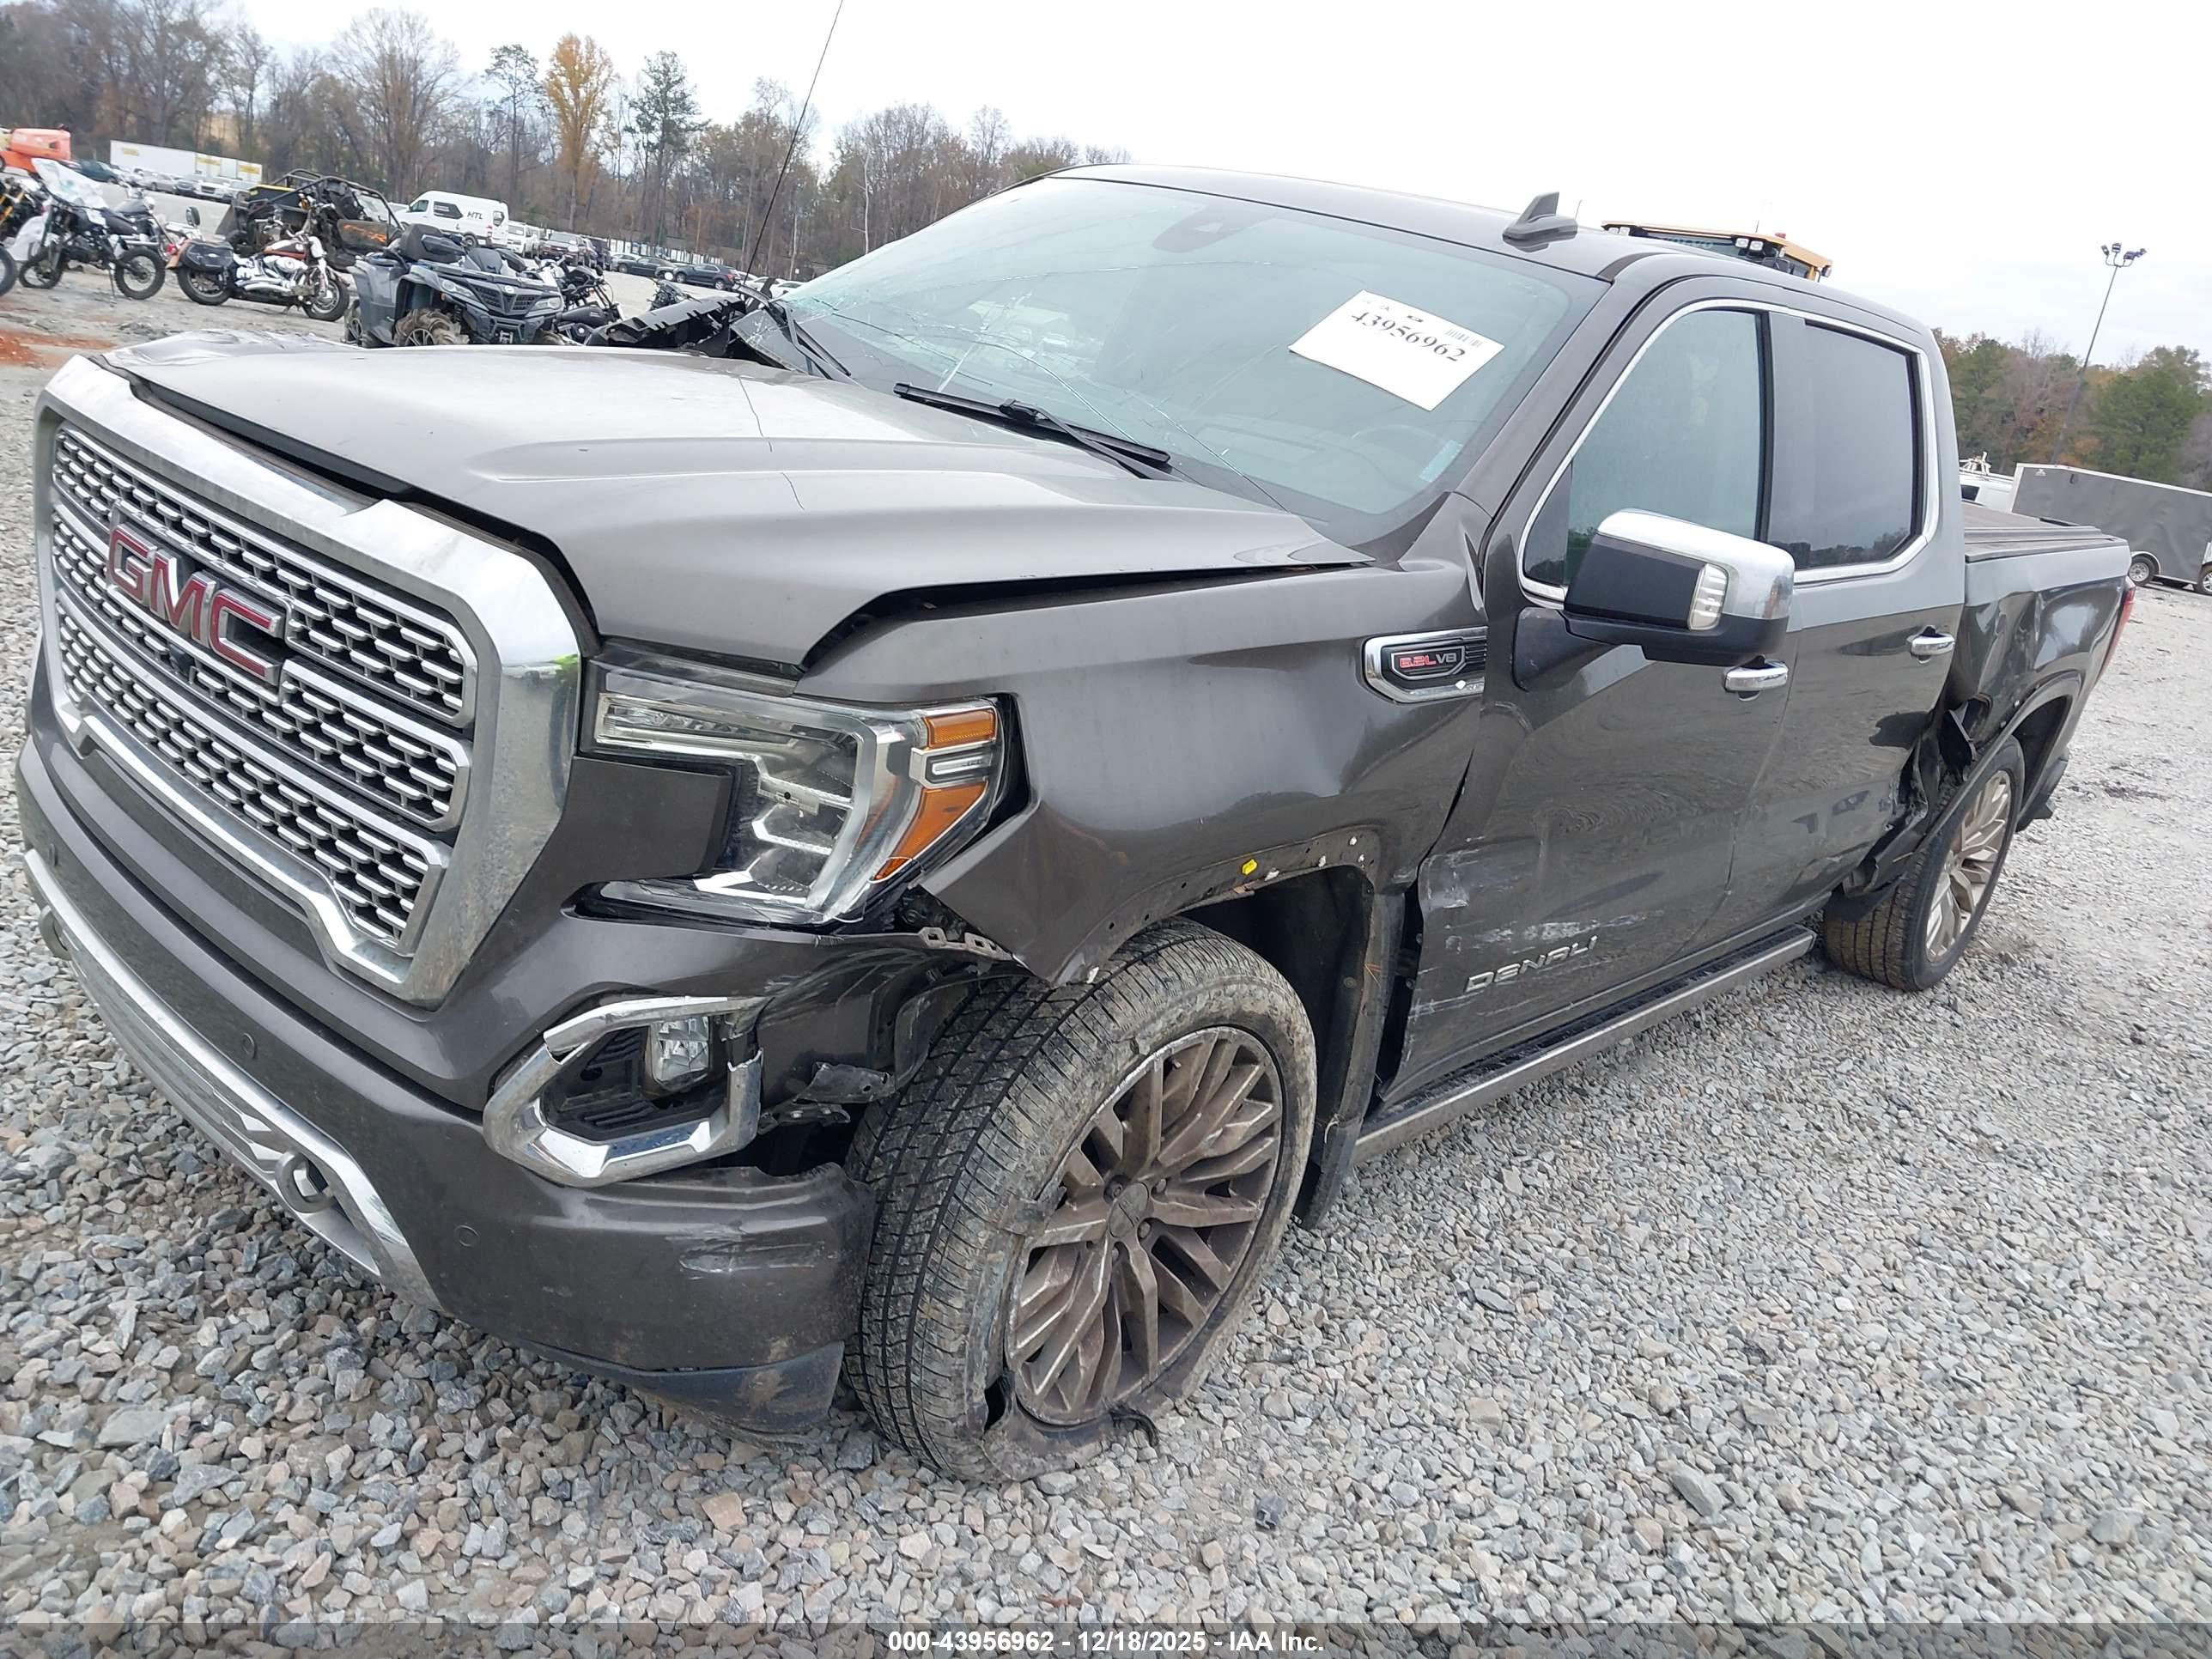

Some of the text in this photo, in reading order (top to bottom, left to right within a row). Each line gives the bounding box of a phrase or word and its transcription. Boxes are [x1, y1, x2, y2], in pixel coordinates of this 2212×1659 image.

[1351, 312, 1466, 362] 43956962
[108, 523, 282, 687] GMC
[1465, 934, 1598, 994] DENALI
